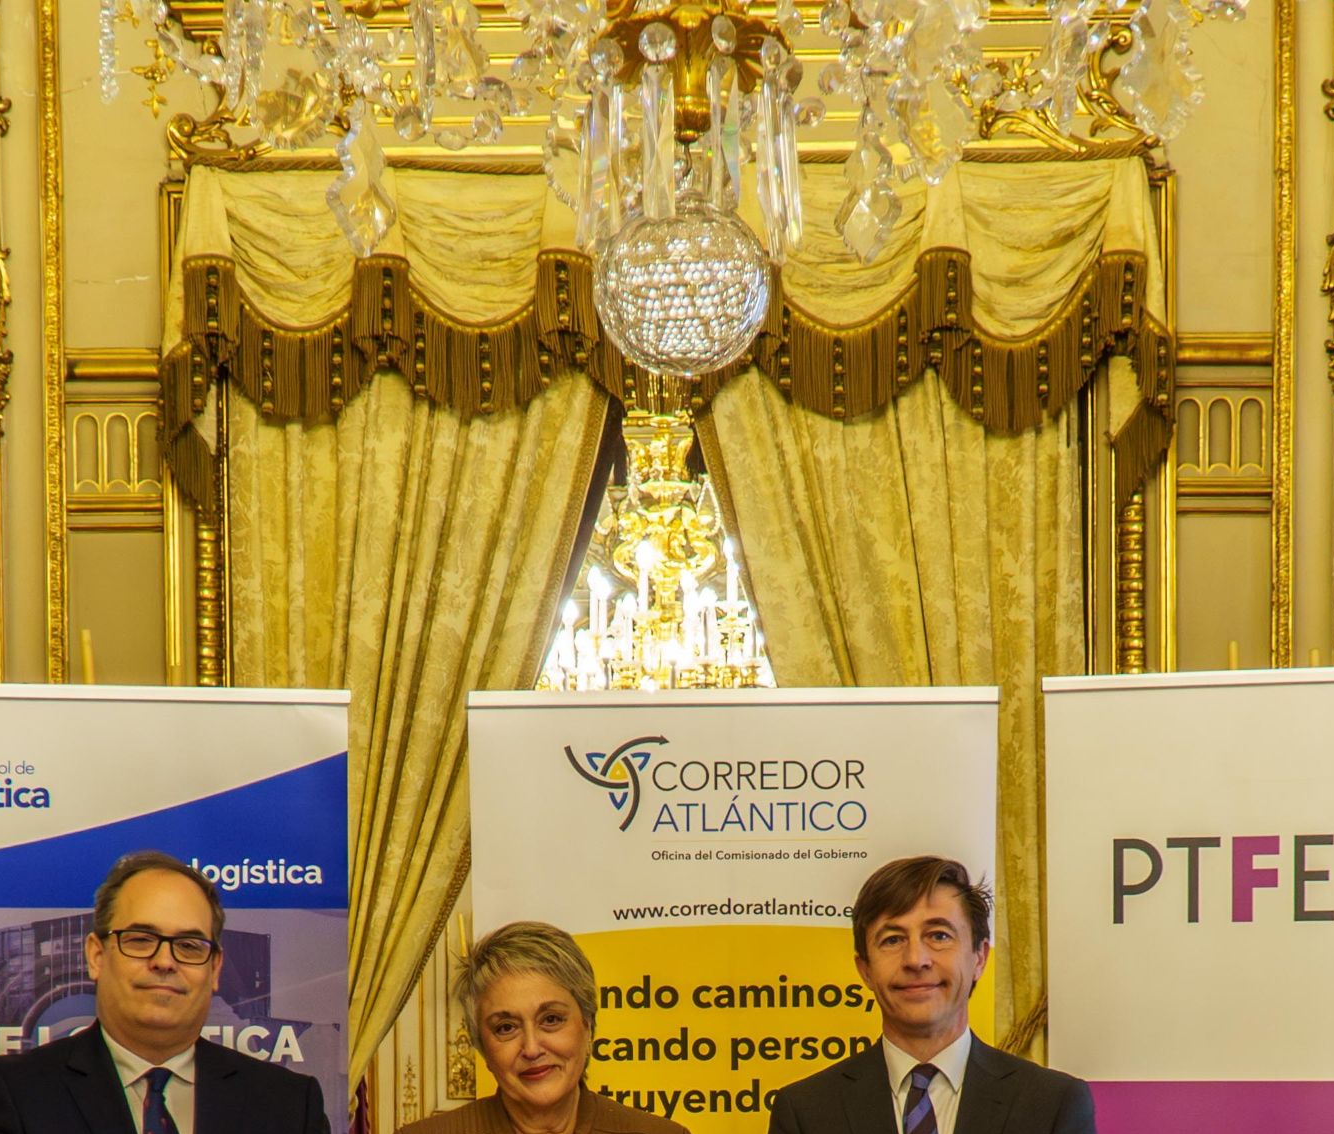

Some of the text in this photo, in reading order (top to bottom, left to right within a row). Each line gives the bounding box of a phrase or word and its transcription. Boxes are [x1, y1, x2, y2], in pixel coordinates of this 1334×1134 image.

[15, 760, 35, 775] de
[652, 760, 865, 791] CORREDOR
[652, 795, 867, 832] ATLÁNTICO
[652, 849, 867, 861] Oficina del Comisionado del Gobierno
[187, 858, 323, 891] logística
[1112, 834, 1334, 924] PTFE
[613, 898, 854, 920] www.corredoratlantico.e
[692, 975, 875, 1012] caminos,
[730, 1034, 873, 1071] person
